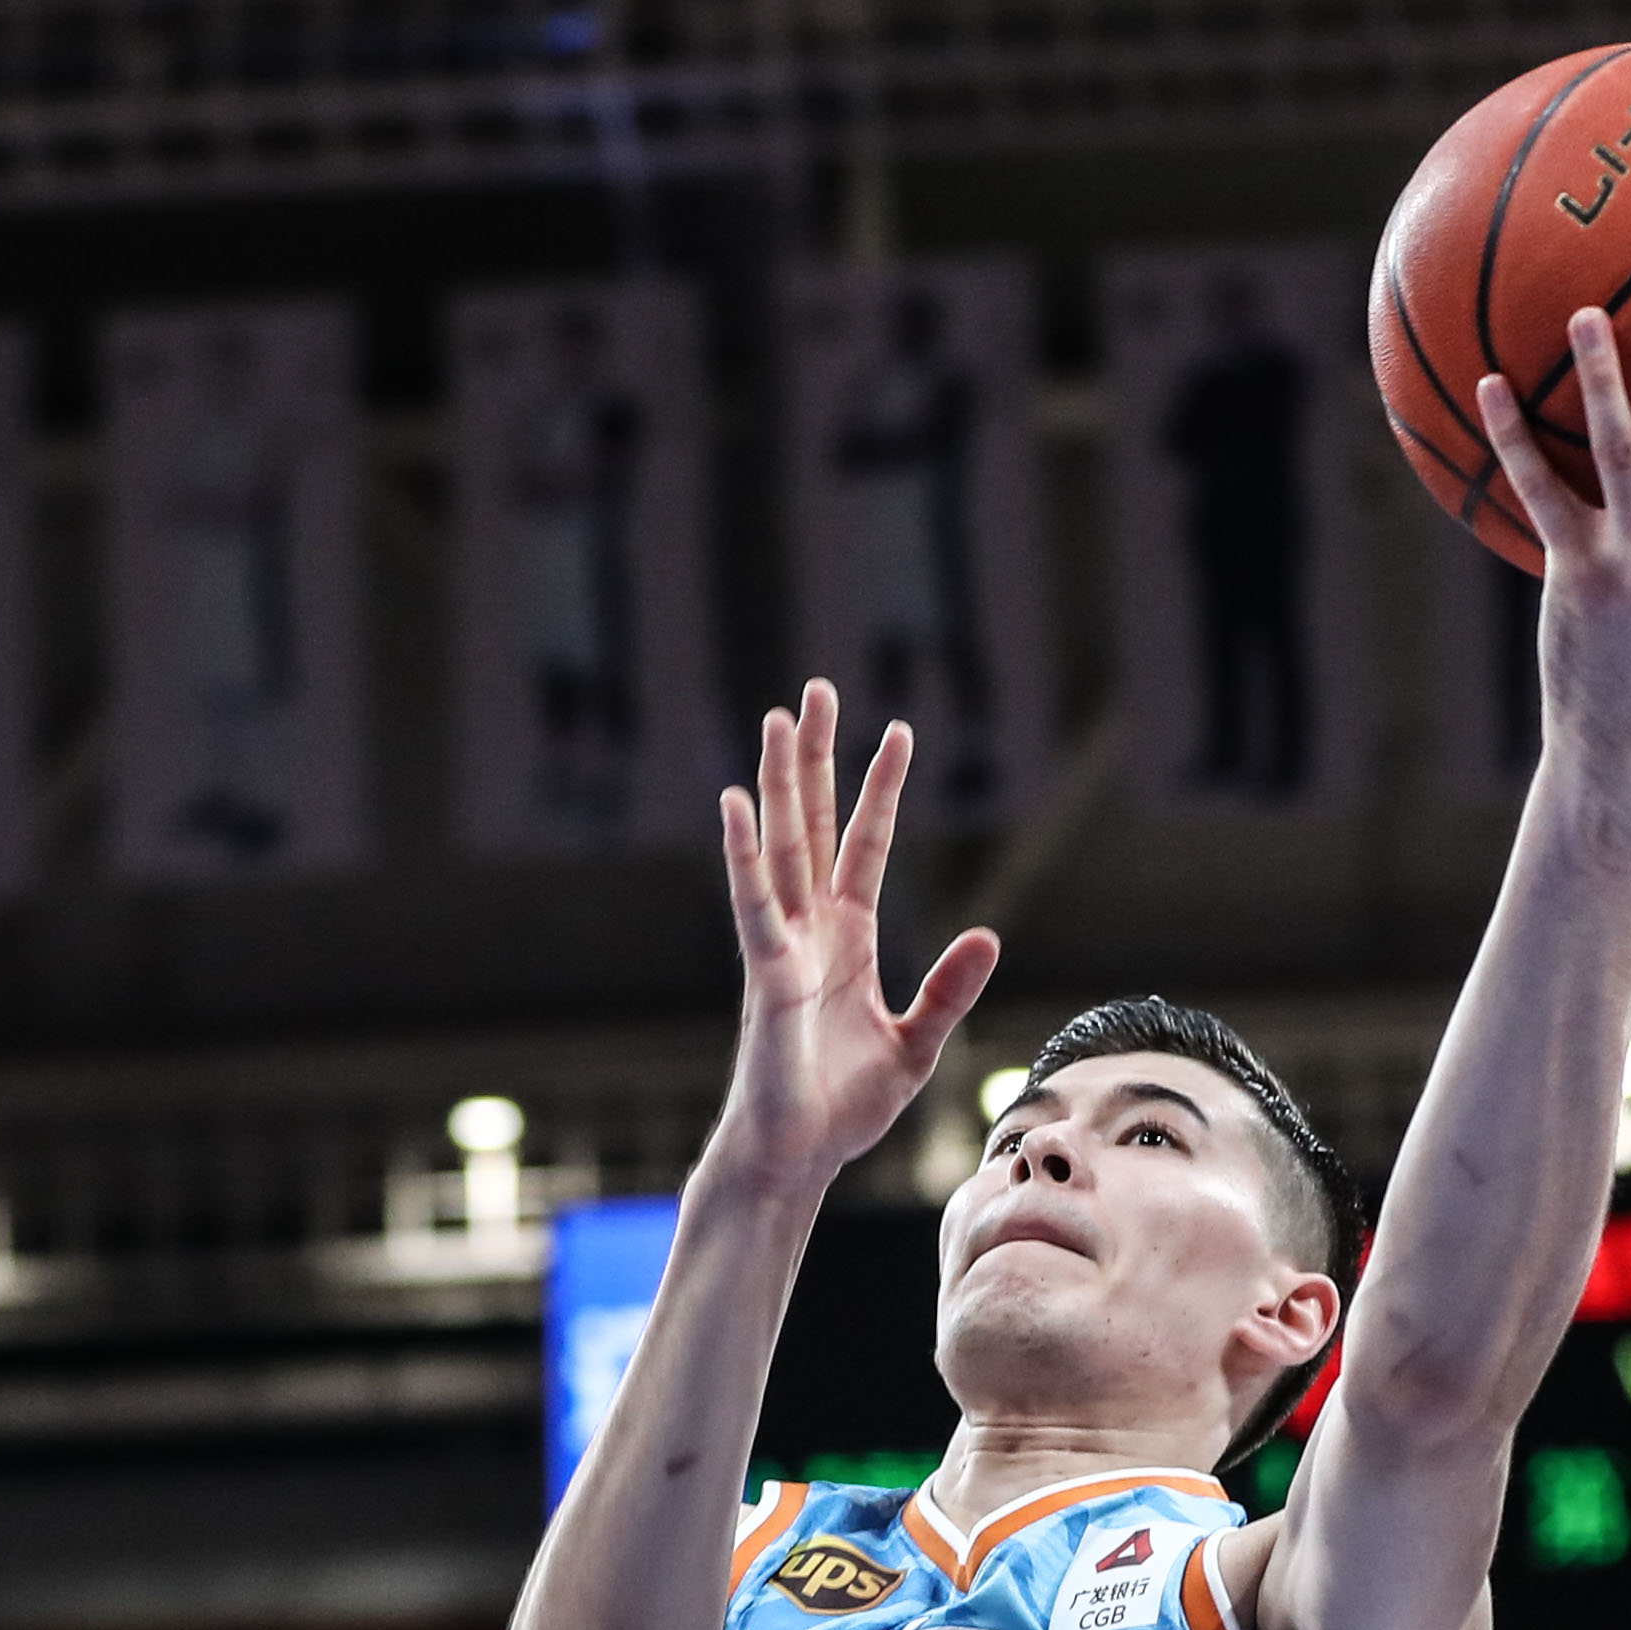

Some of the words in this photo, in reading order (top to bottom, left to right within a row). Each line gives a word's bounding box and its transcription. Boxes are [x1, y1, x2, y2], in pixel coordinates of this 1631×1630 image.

[778, 1552, 887, 1599] ups
[1069, 1576, 1151, 1611] 广发银行
[1079, 1604, 1127, 1630] CGB
